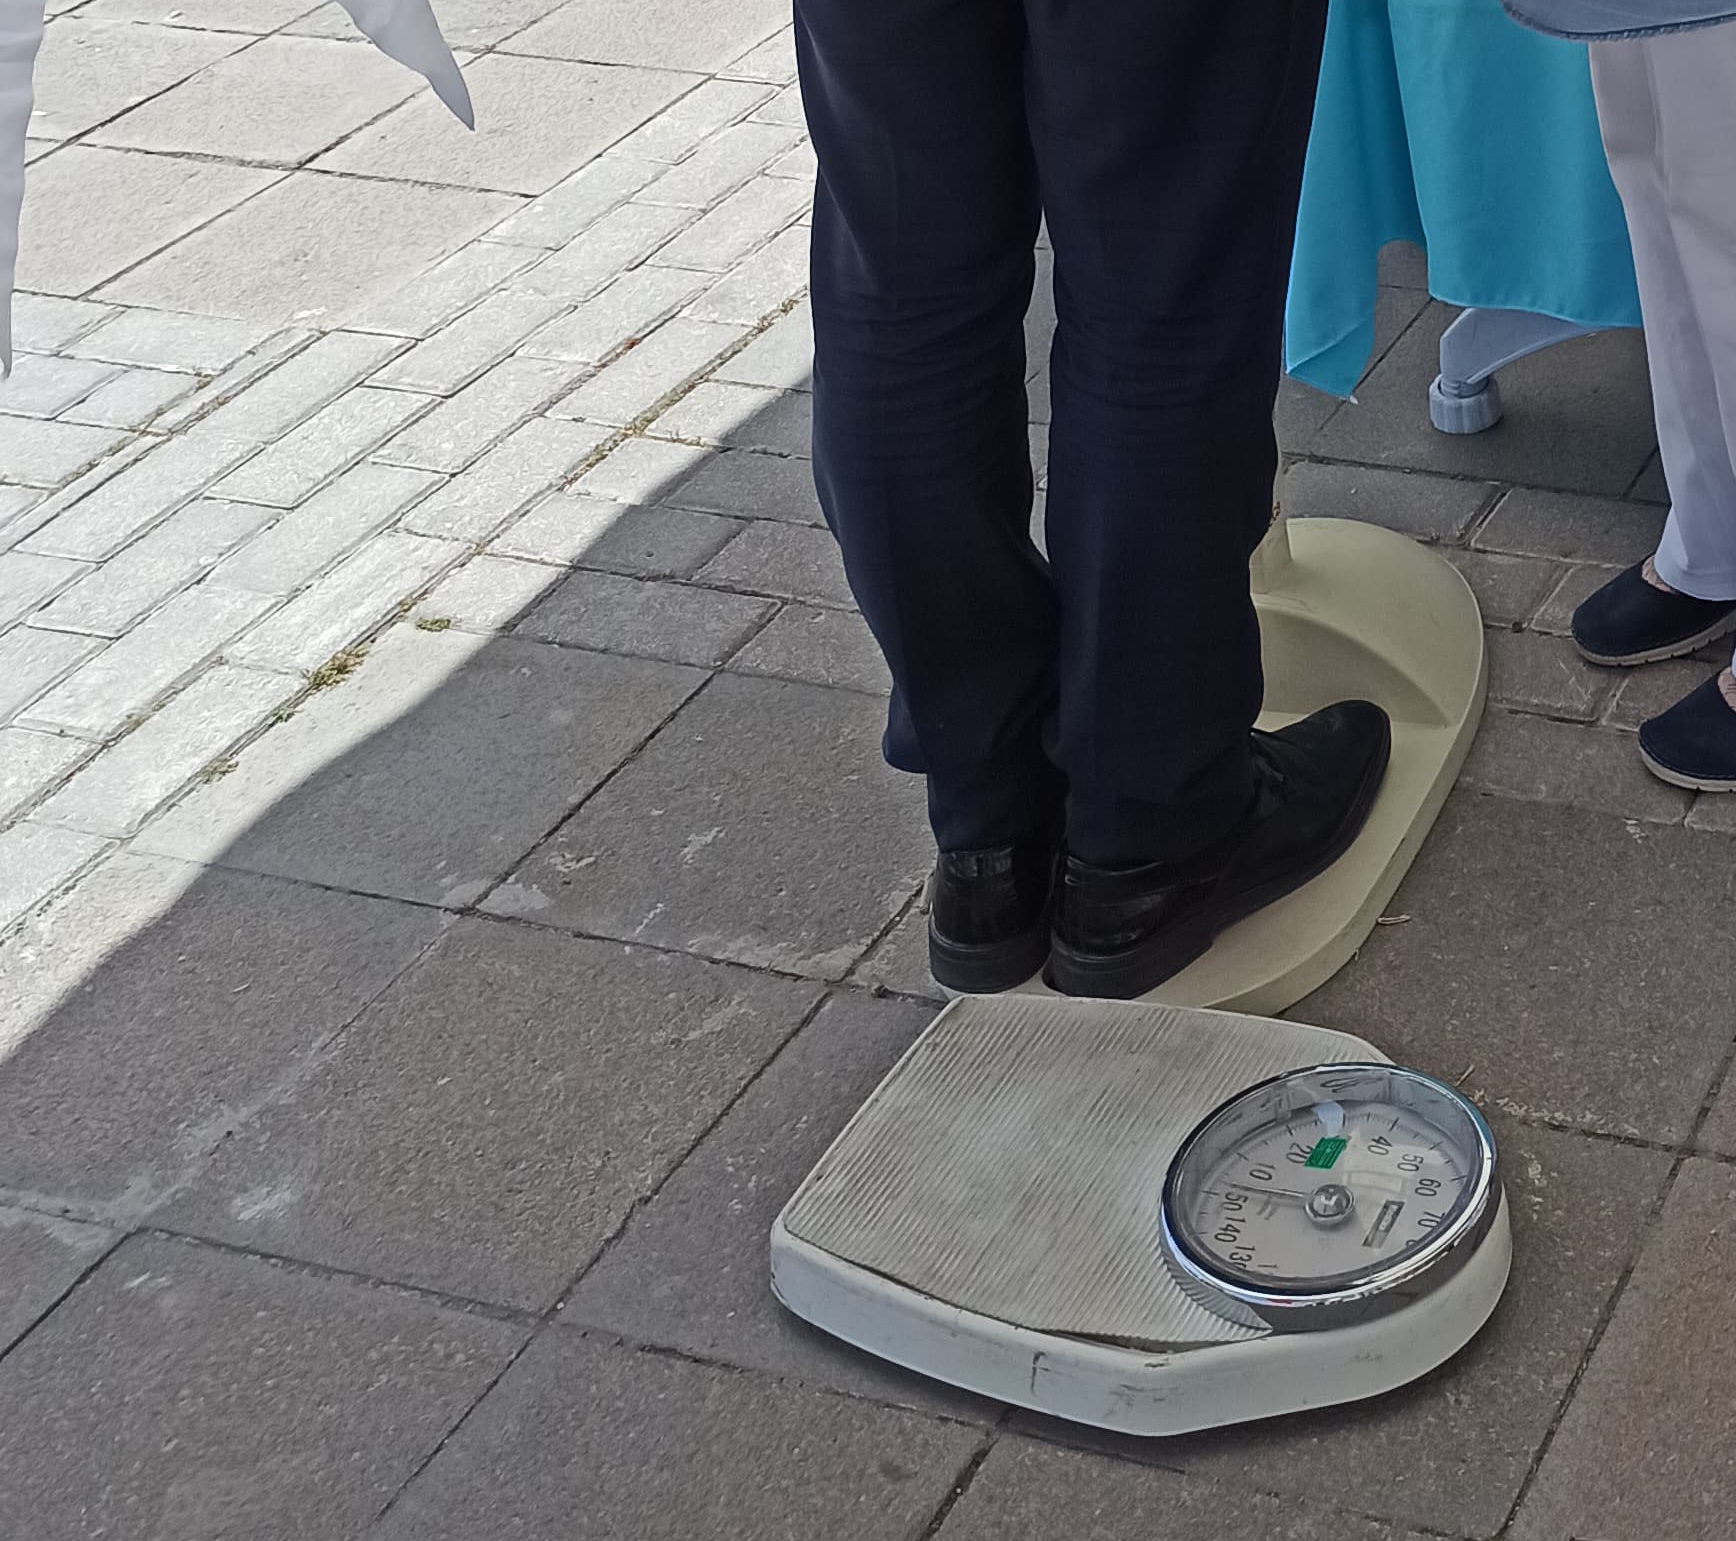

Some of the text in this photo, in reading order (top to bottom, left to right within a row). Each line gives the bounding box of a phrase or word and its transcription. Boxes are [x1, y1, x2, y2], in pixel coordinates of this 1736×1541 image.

[1367, 1135, 1393, 1156] 40
[1249, 1162, 1277, 1181] 10
[1397, 1153, 1425, 1173] 50
[1414, 1178, 1442, 1198] 60
[1417, 1211, 1446, 1229] 70
[1214, 1217, 1247, 1244] 140
